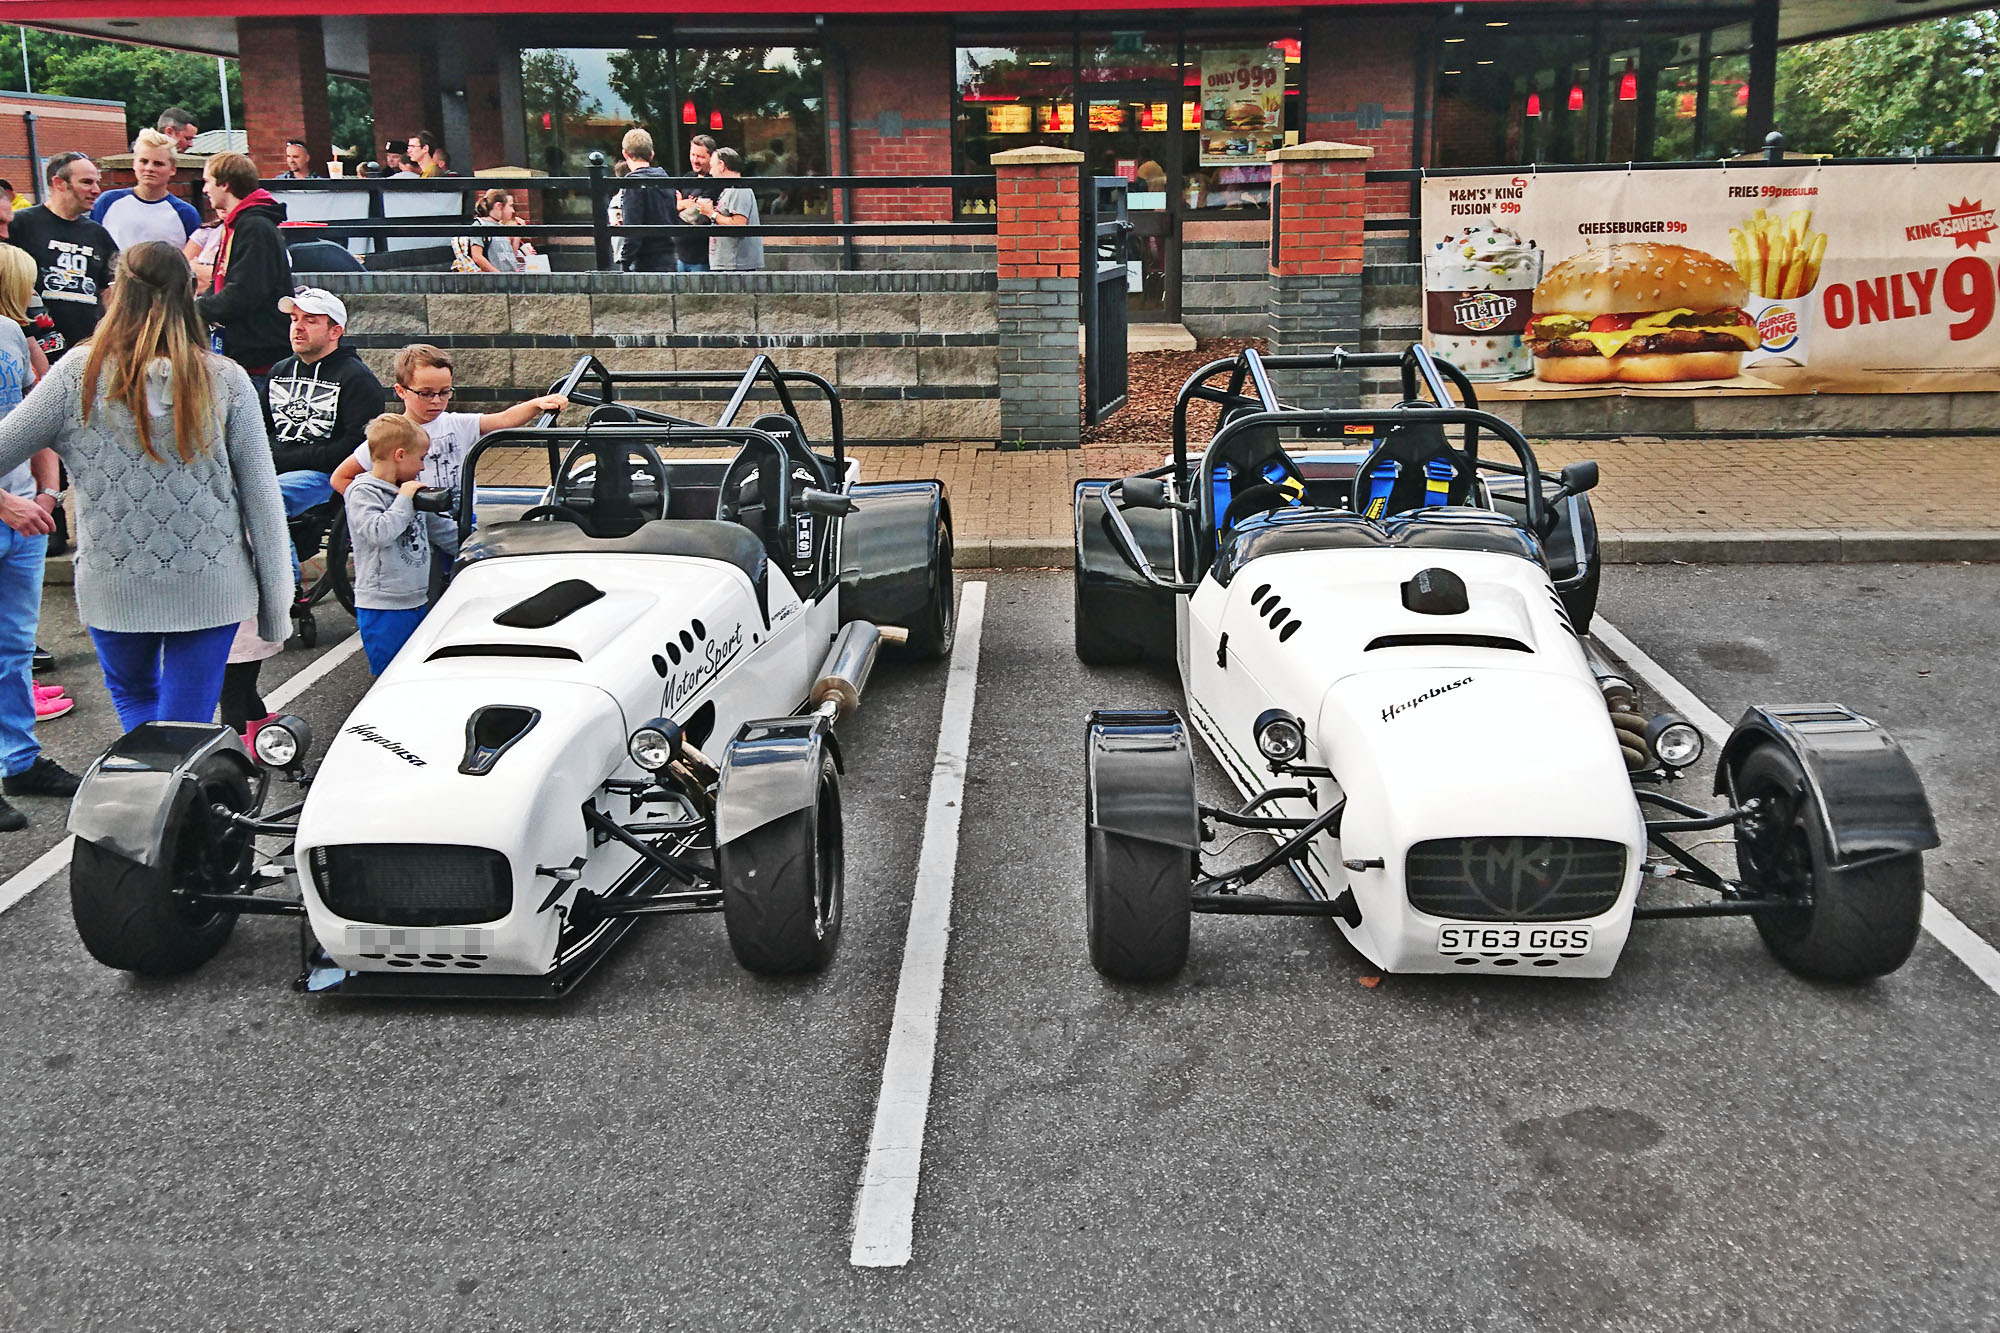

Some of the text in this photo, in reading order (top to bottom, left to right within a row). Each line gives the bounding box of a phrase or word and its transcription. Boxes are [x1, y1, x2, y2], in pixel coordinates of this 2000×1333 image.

[1207, 65, 1277, 91] ONLY 99p
[1495, 187, 1523, 199] KING
[1728, 186, 1819, 198] FRIES 99p REGULAR
[1500, 202, 1521, 214] 99p
[1578, 221, 1687, 234] CHEESEBURGER 99p
[1905, 212, 1995, 242] KING SAVERS
[57, 253, 88, 273] 40
[1823, 256, 2000, 342] ONLY 9
[1759, 312, 1796, 331] BURGER
[1760, 321, 1797, 340] KING
[1381, 676, 1475, 723] Hayabusa
[344, 723, 427, 768] Hayabusa
[1441, 929, 1590, 949] ST63 GGS
